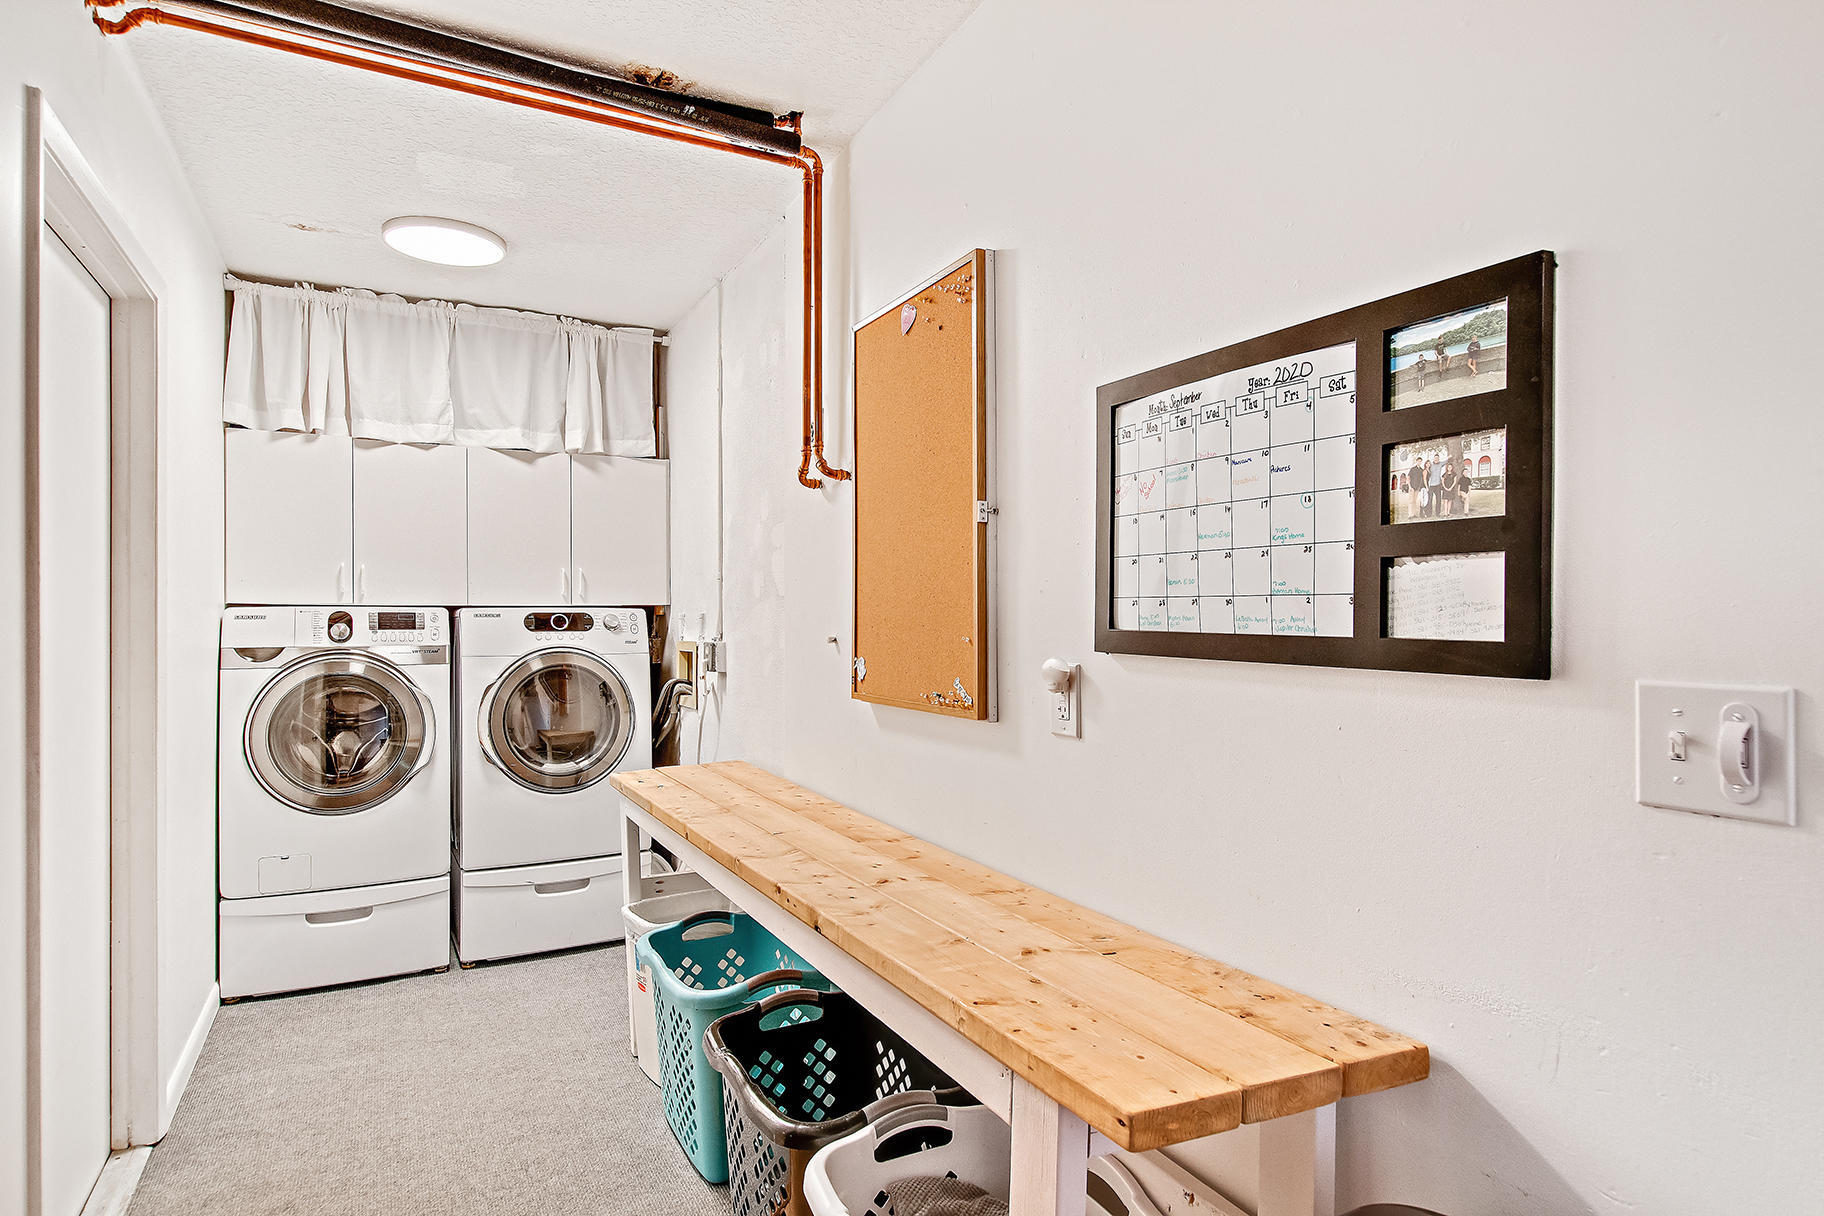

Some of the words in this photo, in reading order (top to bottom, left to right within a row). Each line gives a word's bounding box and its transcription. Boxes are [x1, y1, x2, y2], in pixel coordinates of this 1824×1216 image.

[1273, 361, 1313, 385] 2020
[1242, 398, 1258, 411] Thu
[1283, 390, 1299, 403] Fri
[1328, 376, 1346, 392] Sat
[1350, 394, 1355, 403] 5
[1306, 401, 1312, 410] 4
[1263, 410, 1268, 419] 3
[1304, 444, 1310, 452] 11
[1261, 500, 1268, 509] 17
